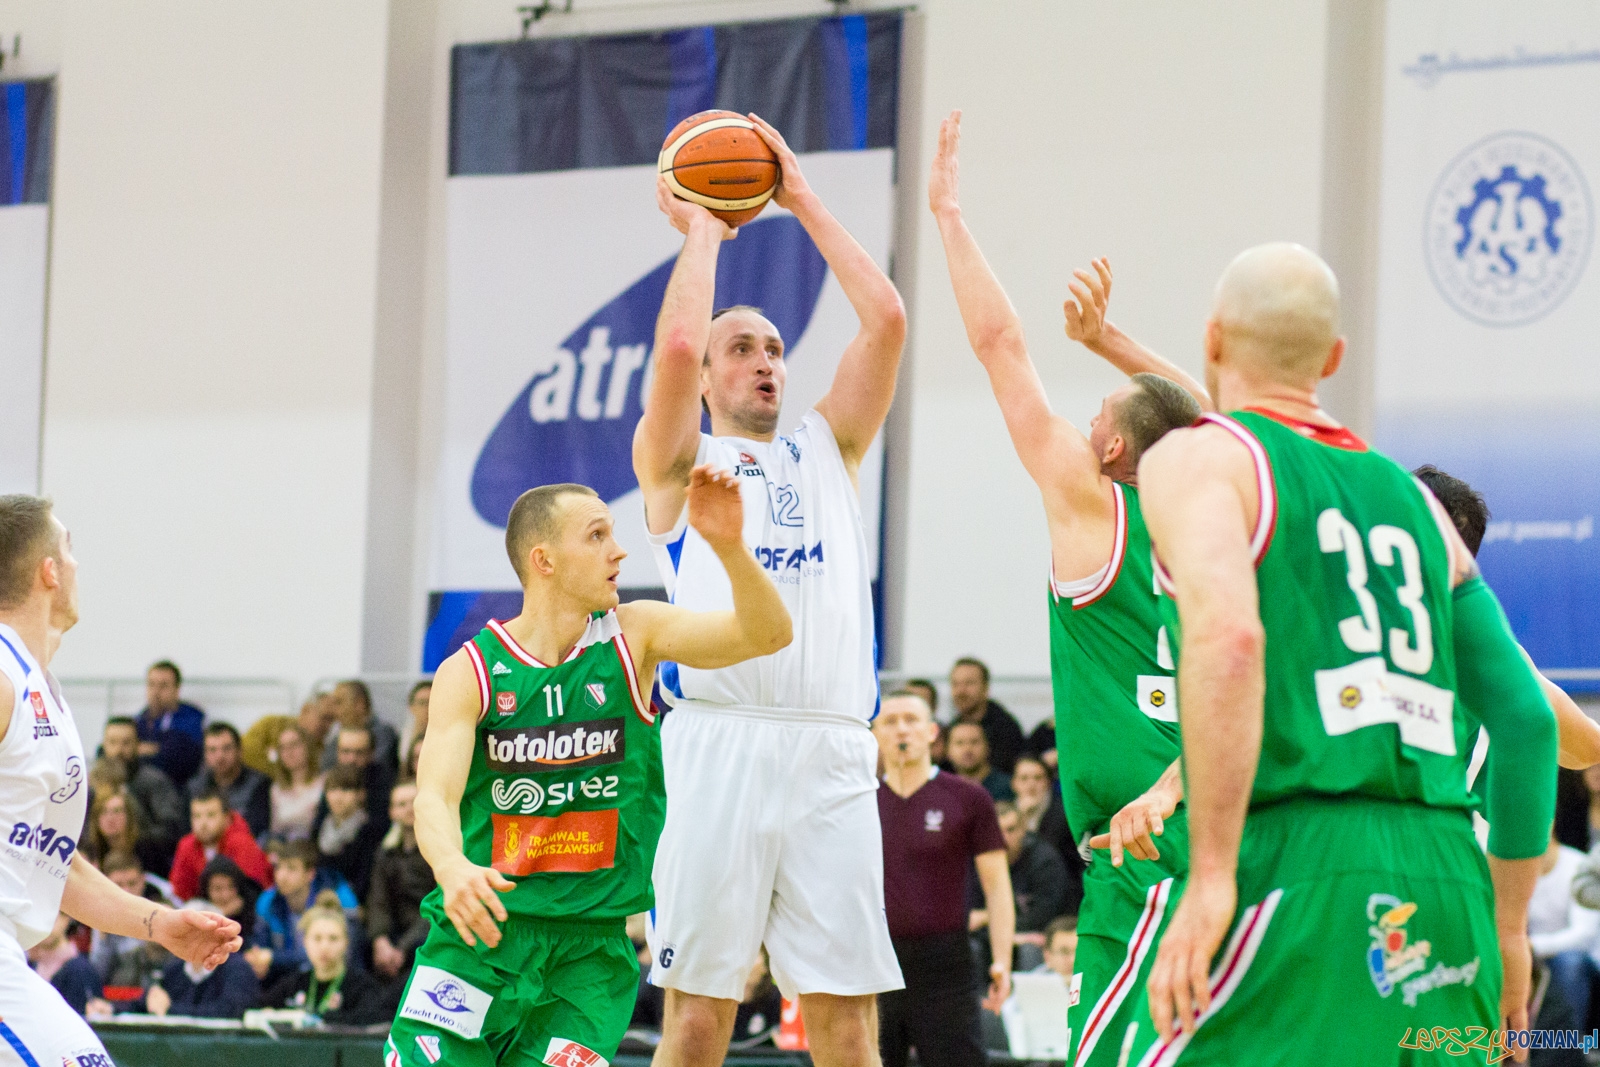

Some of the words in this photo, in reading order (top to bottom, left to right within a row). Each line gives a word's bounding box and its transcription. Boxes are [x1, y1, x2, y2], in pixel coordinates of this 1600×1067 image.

[529, 326, 654, 424] atr
[1317, 507, 1433, 675] 33
[542, 683, 564, 718] 11
[487, 727, 620, 764] totolotek
[526, 841, 605, 859] WARSZAWSKIE
[528, 831, 590, 847] TRAMWAJE
[404, 1006, 432, 1019] Fracht
[433, 1013, 455, 1027] FWO
